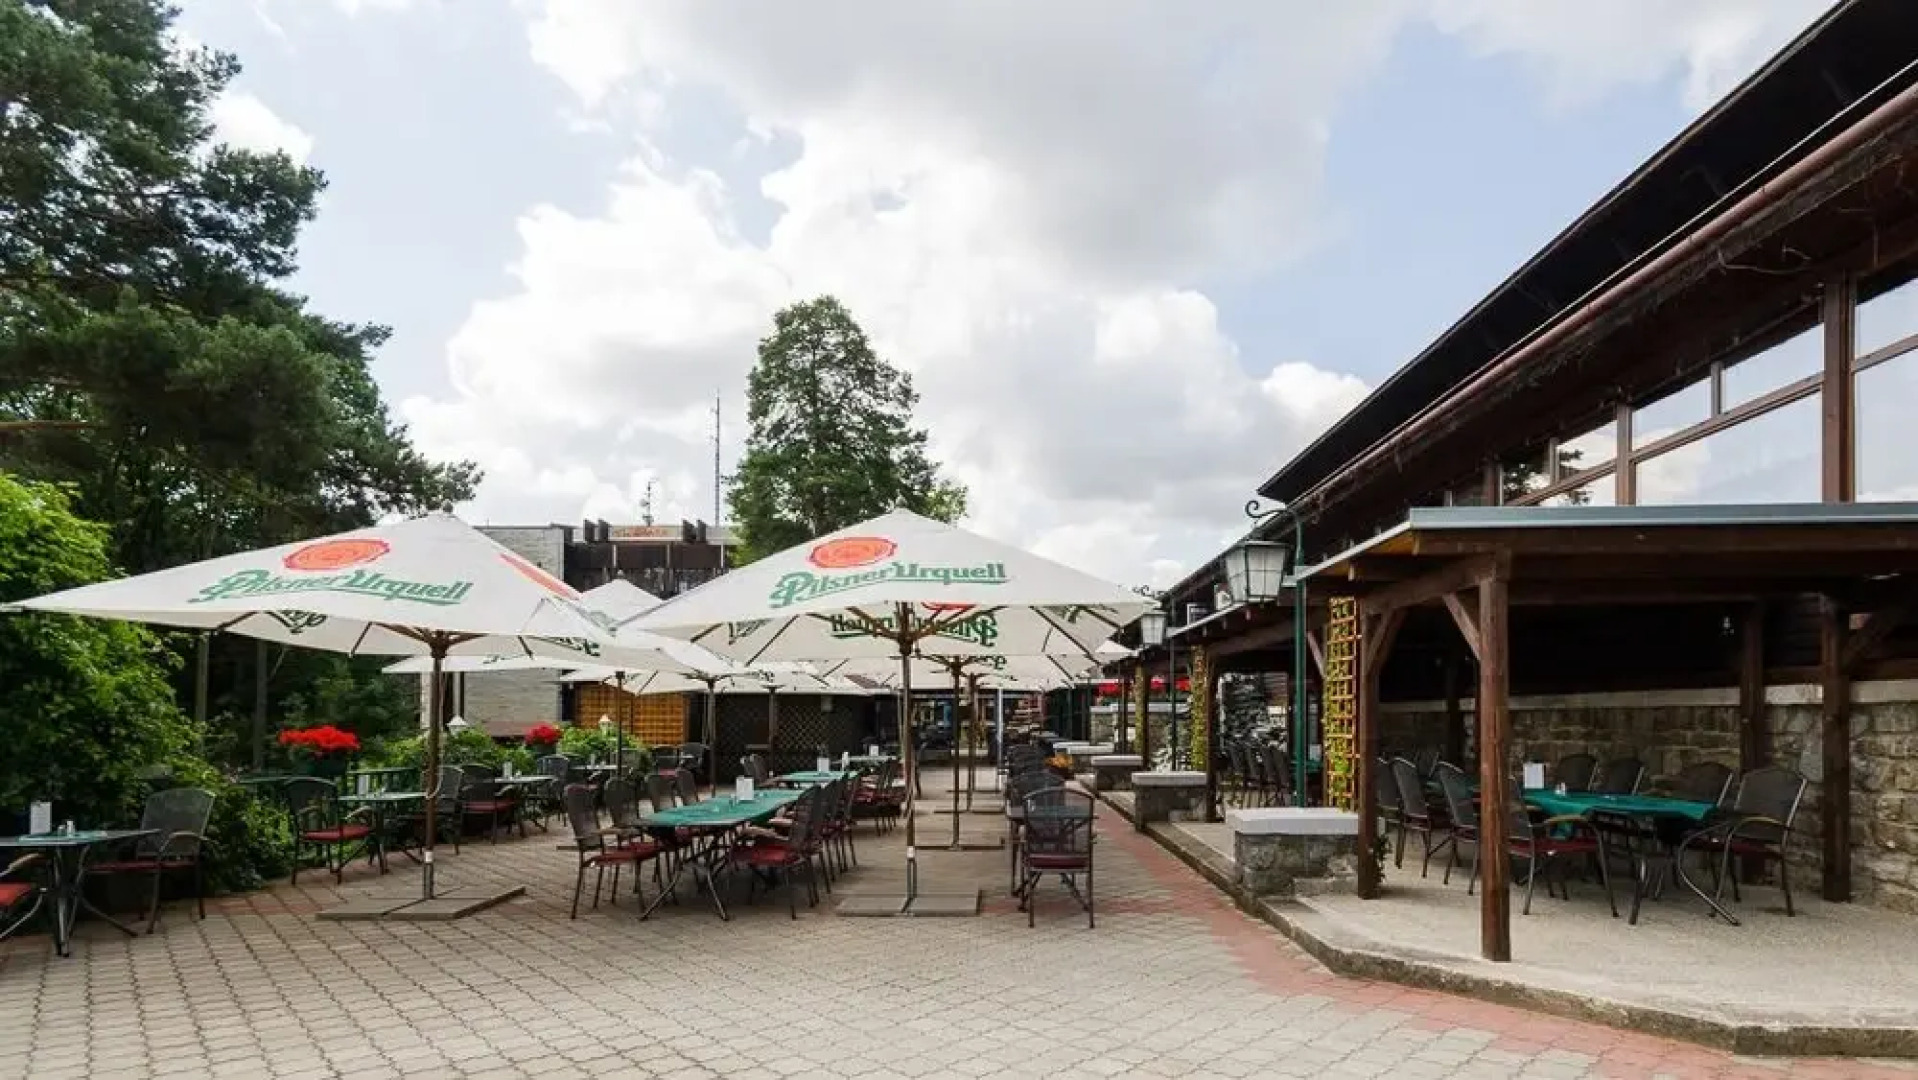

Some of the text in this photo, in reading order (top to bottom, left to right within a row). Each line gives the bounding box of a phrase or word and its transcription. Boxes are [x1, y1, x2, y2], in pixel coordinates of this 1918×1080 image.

[187, 569, 474, 602] Pilsner Urquell
[768, 561, 1005, 608] Pilsner Urquell
